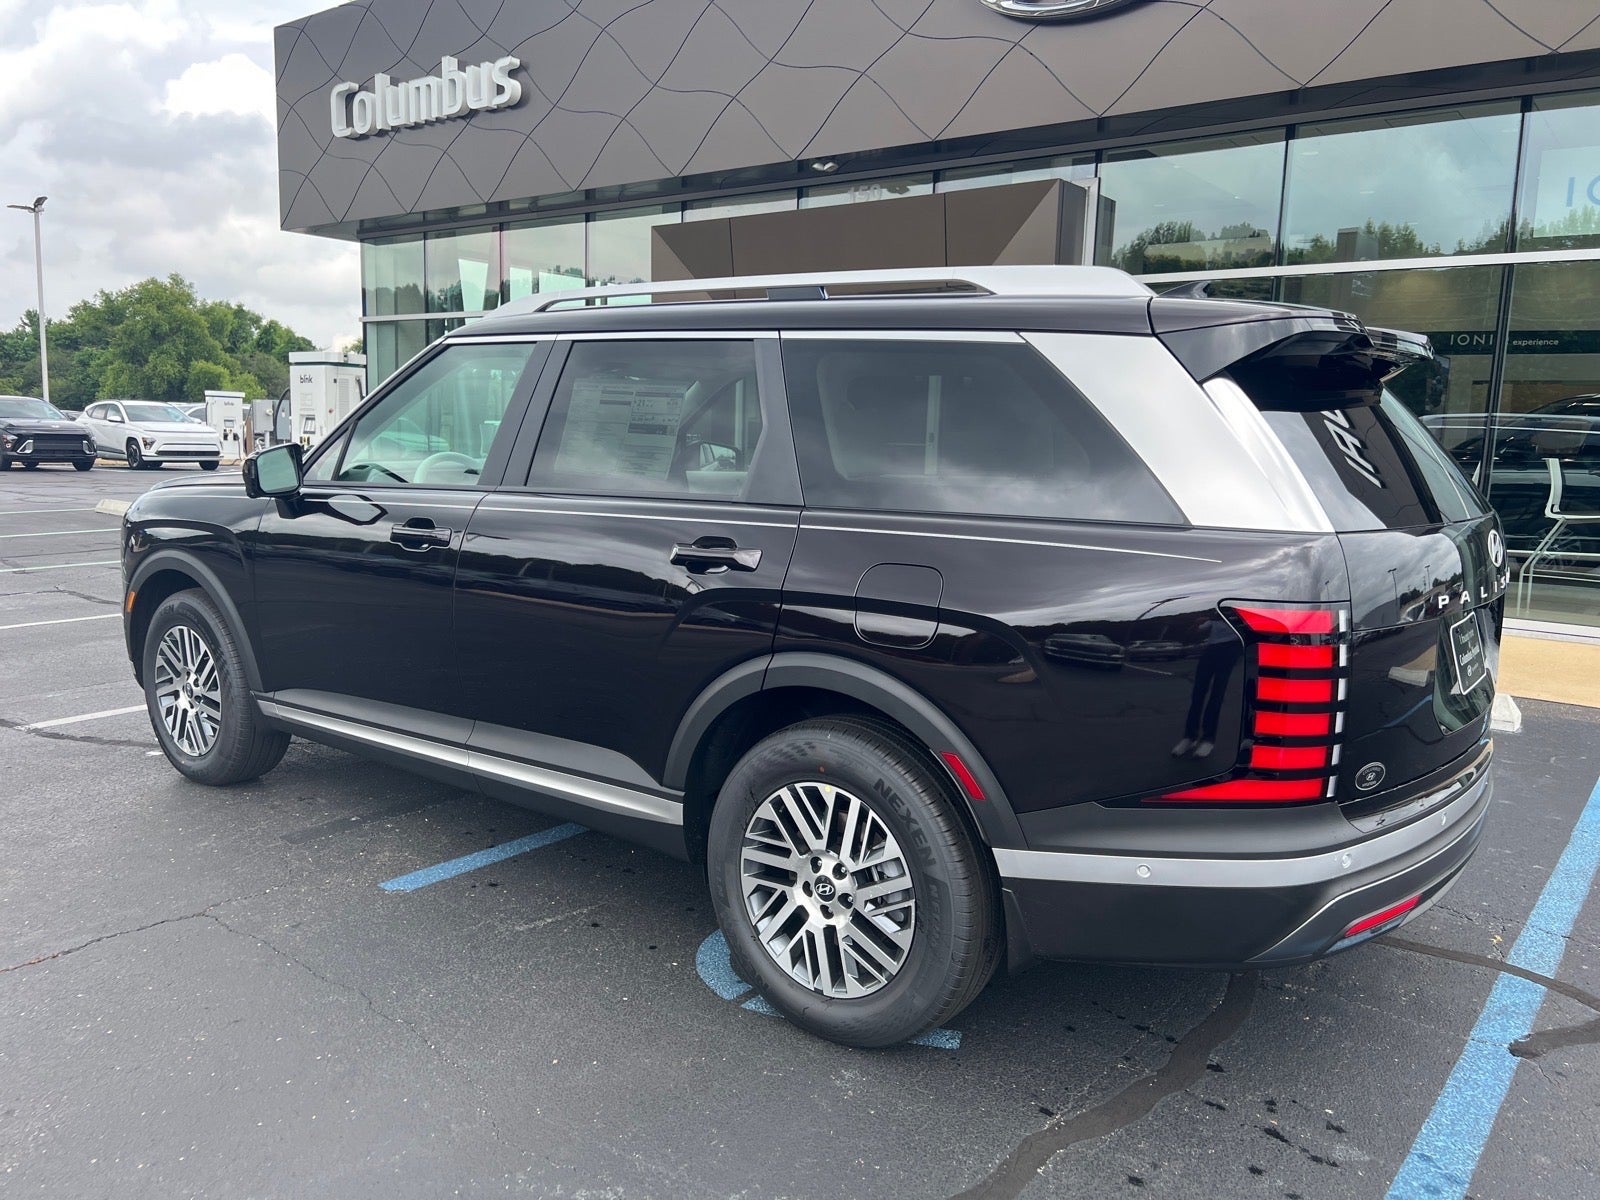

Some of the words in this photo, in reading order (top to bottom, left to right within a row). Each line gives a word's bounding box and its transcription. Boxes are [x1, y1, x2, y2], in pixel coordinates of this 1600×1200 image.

[330, 55, 521, 138] Columbus
[1450, 333, 1508, 346] IONI
[1512, 338, 1559, 346] experience
[873, 778, 936, 867] NEXEN
